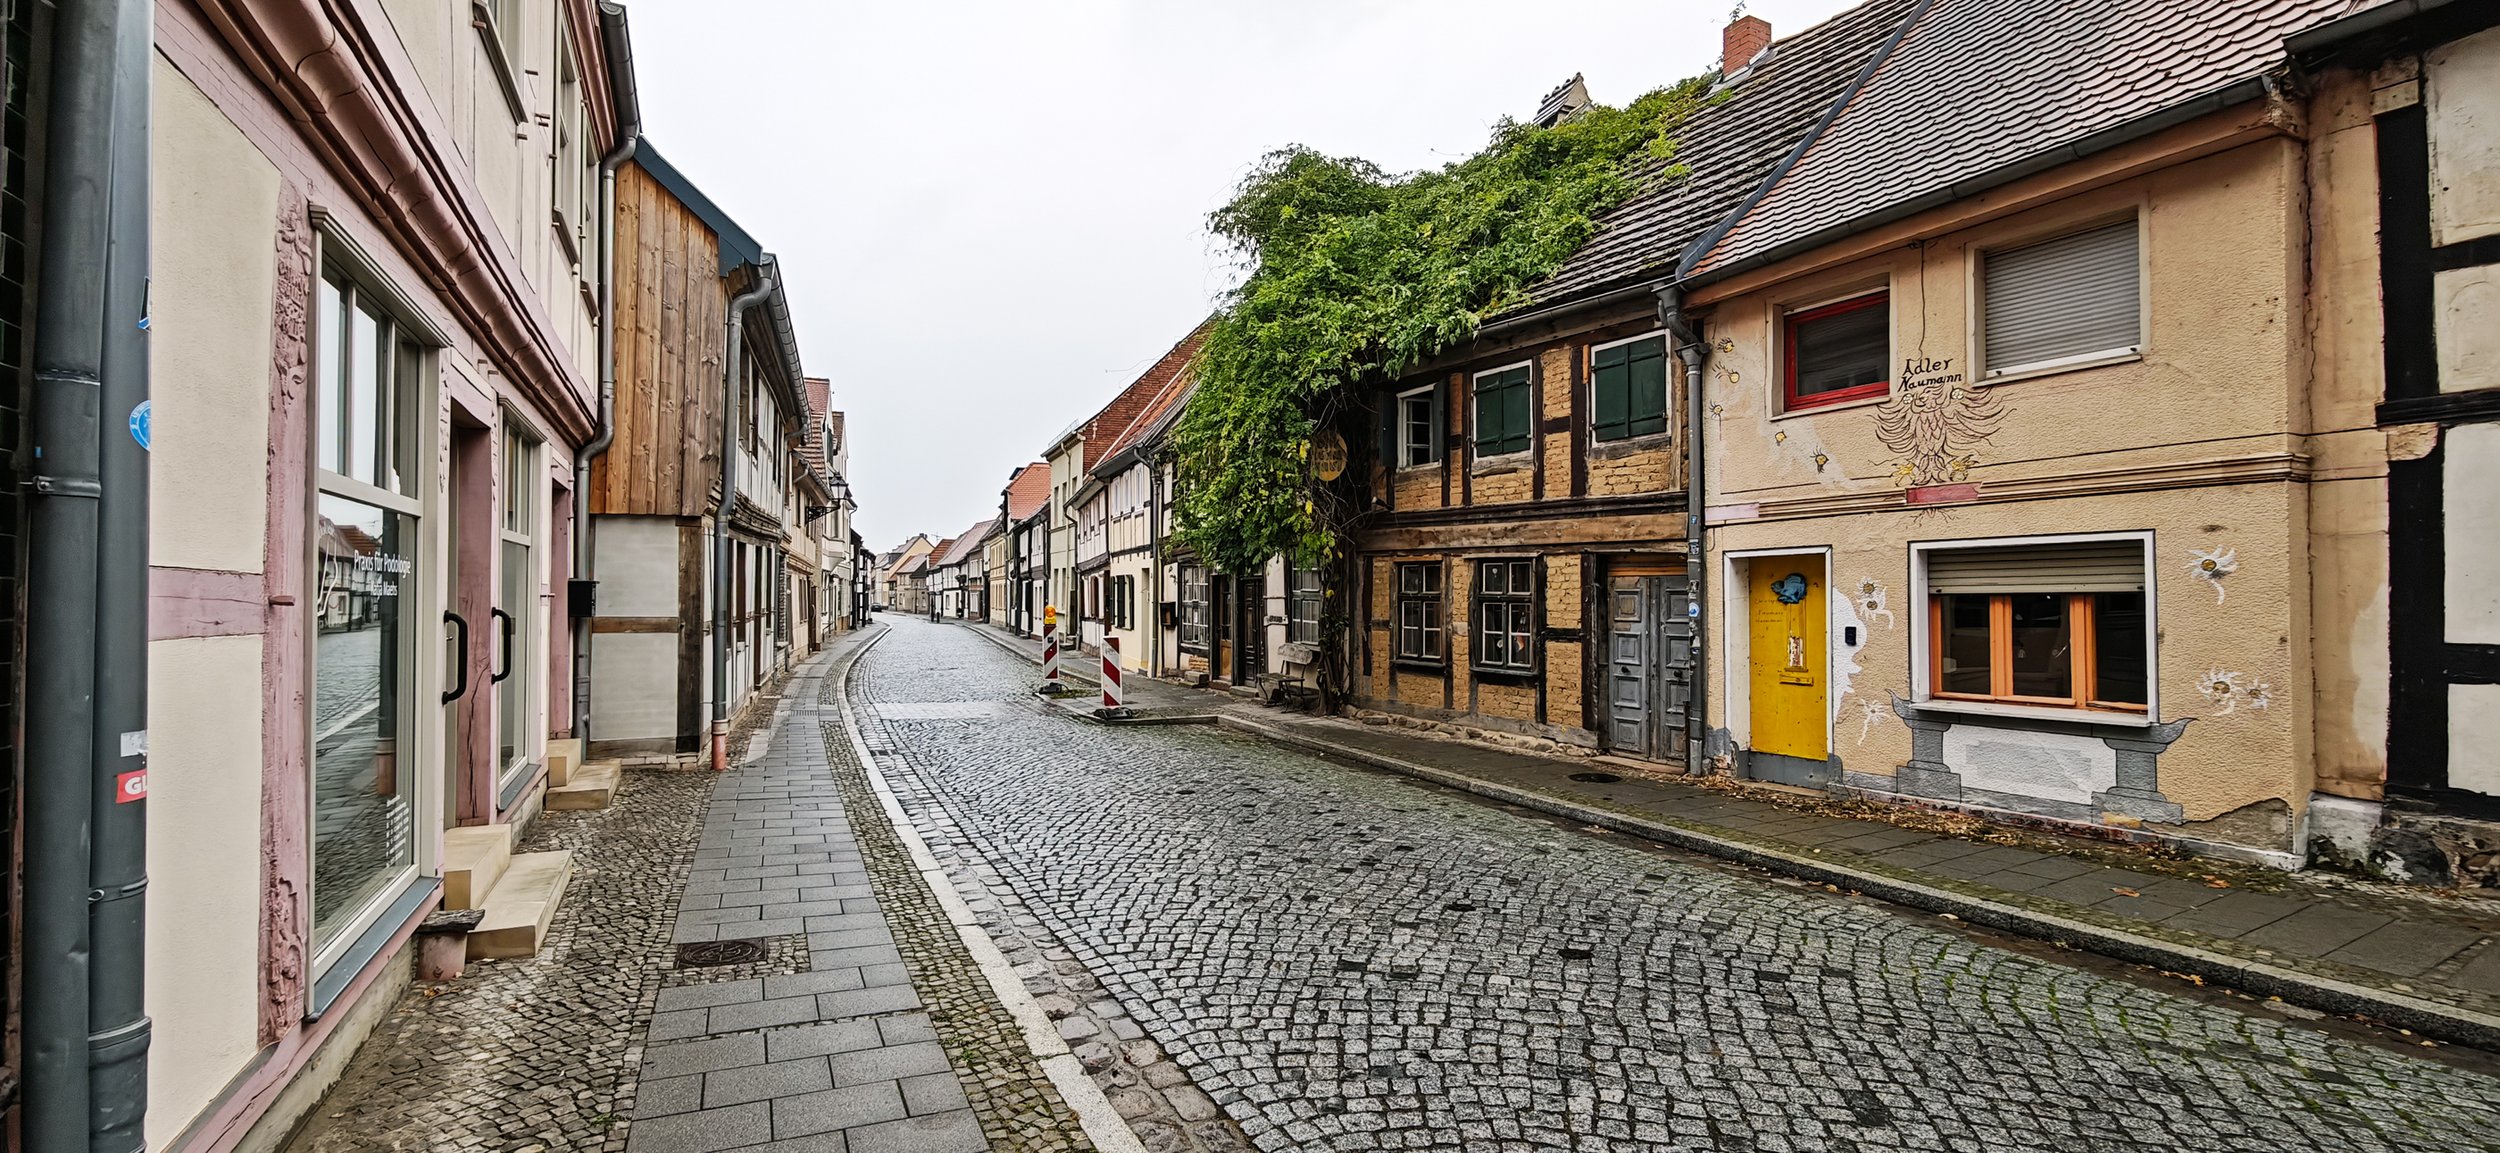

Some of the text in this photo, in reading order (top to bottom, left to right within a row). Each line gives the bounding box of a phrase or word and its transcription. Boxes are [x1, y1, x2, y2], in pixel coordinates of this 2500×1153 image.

[1902, 357, 1954, 377] Adler
[1897, 372, 1963, 393] Naumann
[354, 549, 411, 578] Praxis für Podologie
[371, 580, 383, 600] Katja
